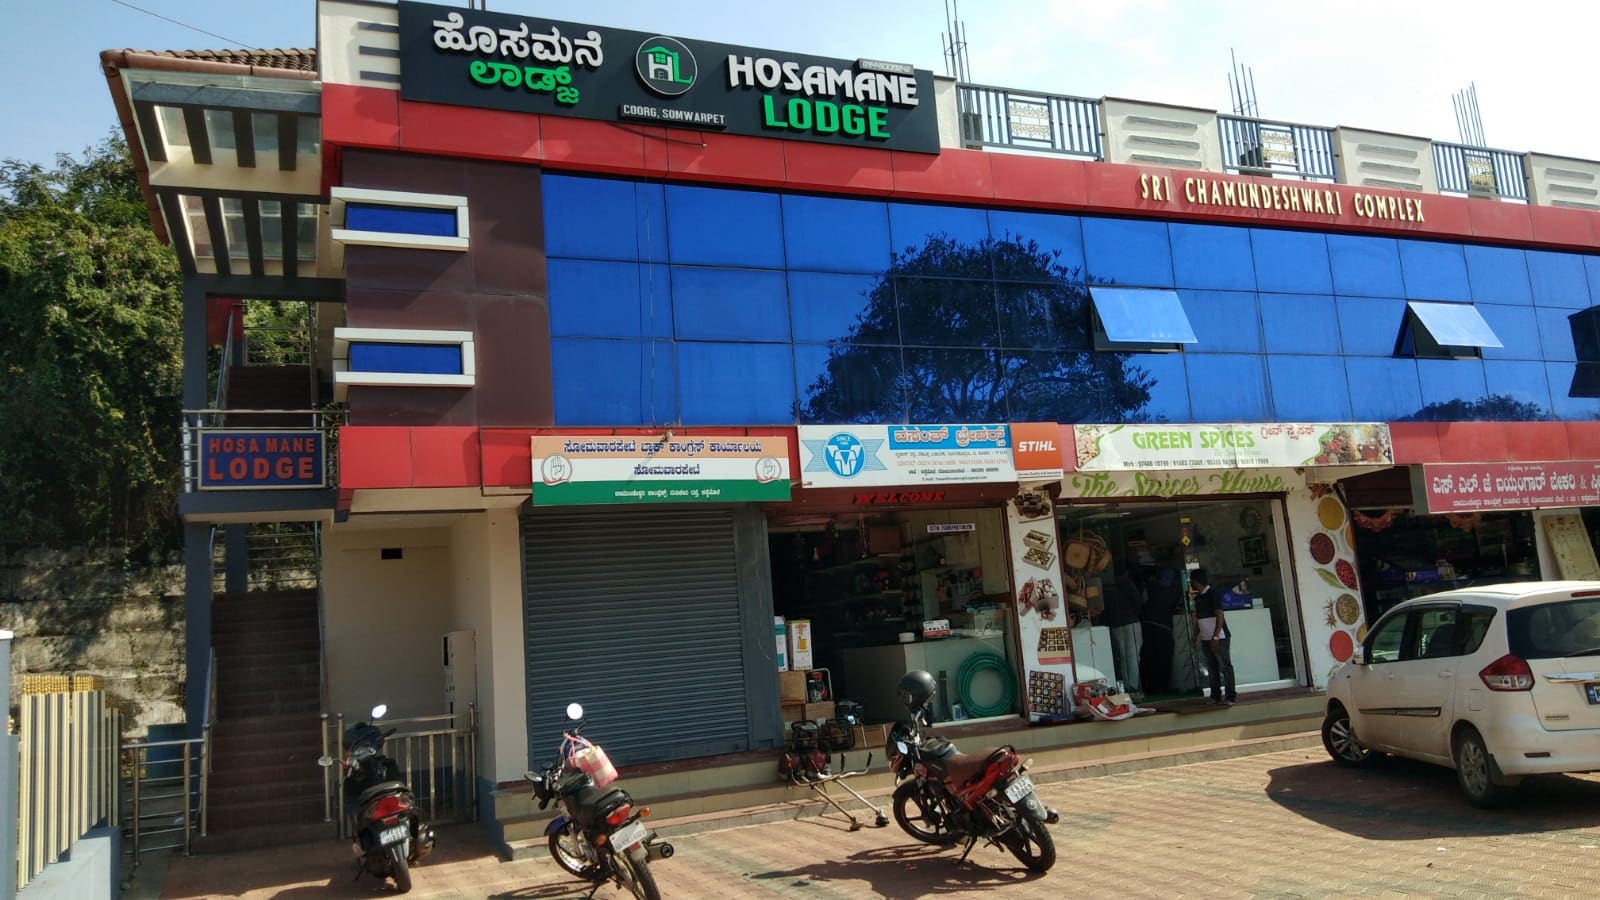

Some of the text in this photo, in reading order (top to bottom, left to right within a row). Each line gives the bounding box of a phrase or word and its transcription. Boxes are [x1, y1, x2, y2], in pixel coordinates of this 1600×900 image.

[433, 12, 603, 67] ಹೊಸಮನೆ
[470, 60, 580, 104] ಲಾಡ್ಜ್
[728, 54, 919, 106] HOSAMANE
[623, 104, 726, 124] COORG, SOMWARPET
[763, 94, 891, 138] LODGE
[1140, 173, 1425, 222] SRI CHAMUNDESHWARI COMPLEX
[209, 437, 316, 454] HOSA MANE
[1018, 440, 1057, 453] STIHL
[1132, 430, 1255, 450] GREEN SPICES
[208, 456, 315, 481] LODGE
[1072, 472, 1118, 497] The
[1124, 471, 1202, 497] Spices
[854, 490, 945, 504] WELCOME
